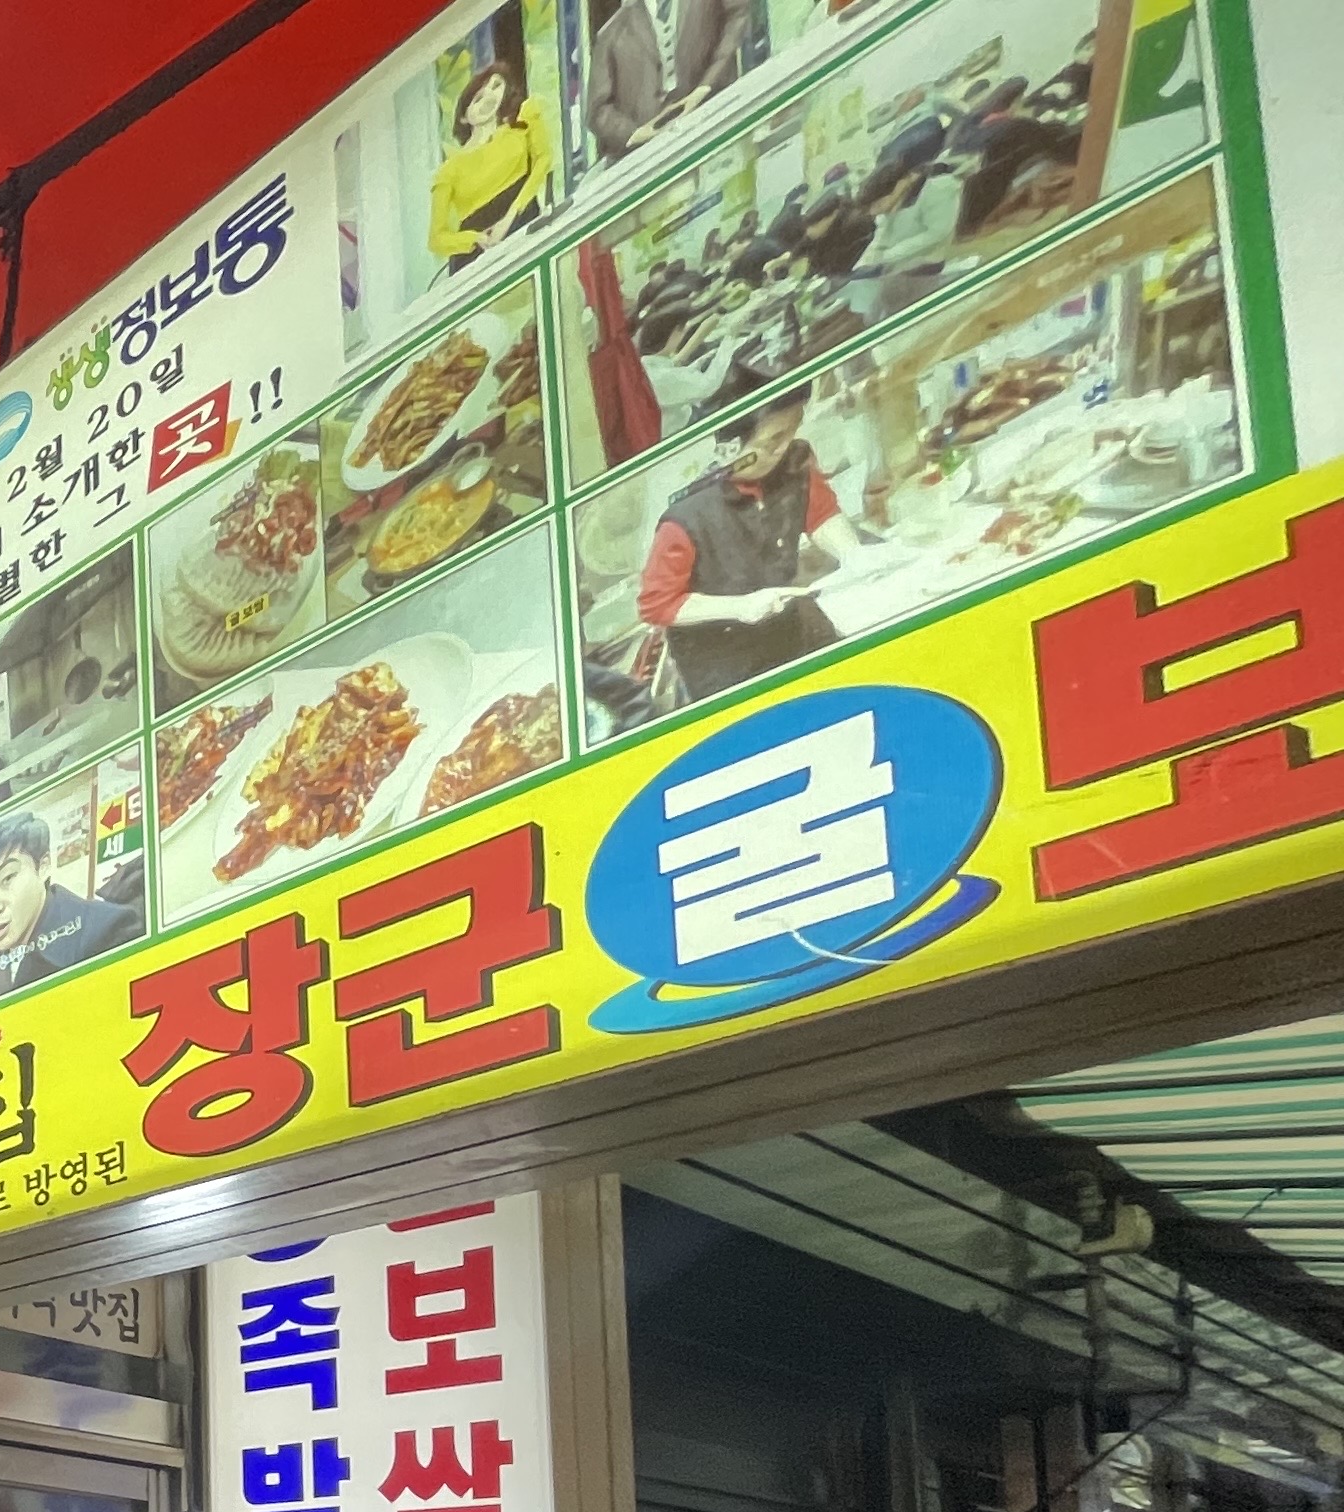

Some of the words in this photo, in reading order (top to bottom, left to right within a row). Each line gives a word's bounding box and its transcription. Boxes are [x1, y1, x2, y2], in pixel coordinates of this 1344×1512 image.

[45, 173, 295, 411] 생생정보통
[7, 434, 64, 496] 2월
[87, 342, 187, 447] 20일
[21, 429, 147, 534] 소개한
[92, 489, 132, 527] 그
[160, 402, 221, 478] 곳
[122, 822, 561, 1158] 장군
[24, 1139, 129, 1205] 방영된
